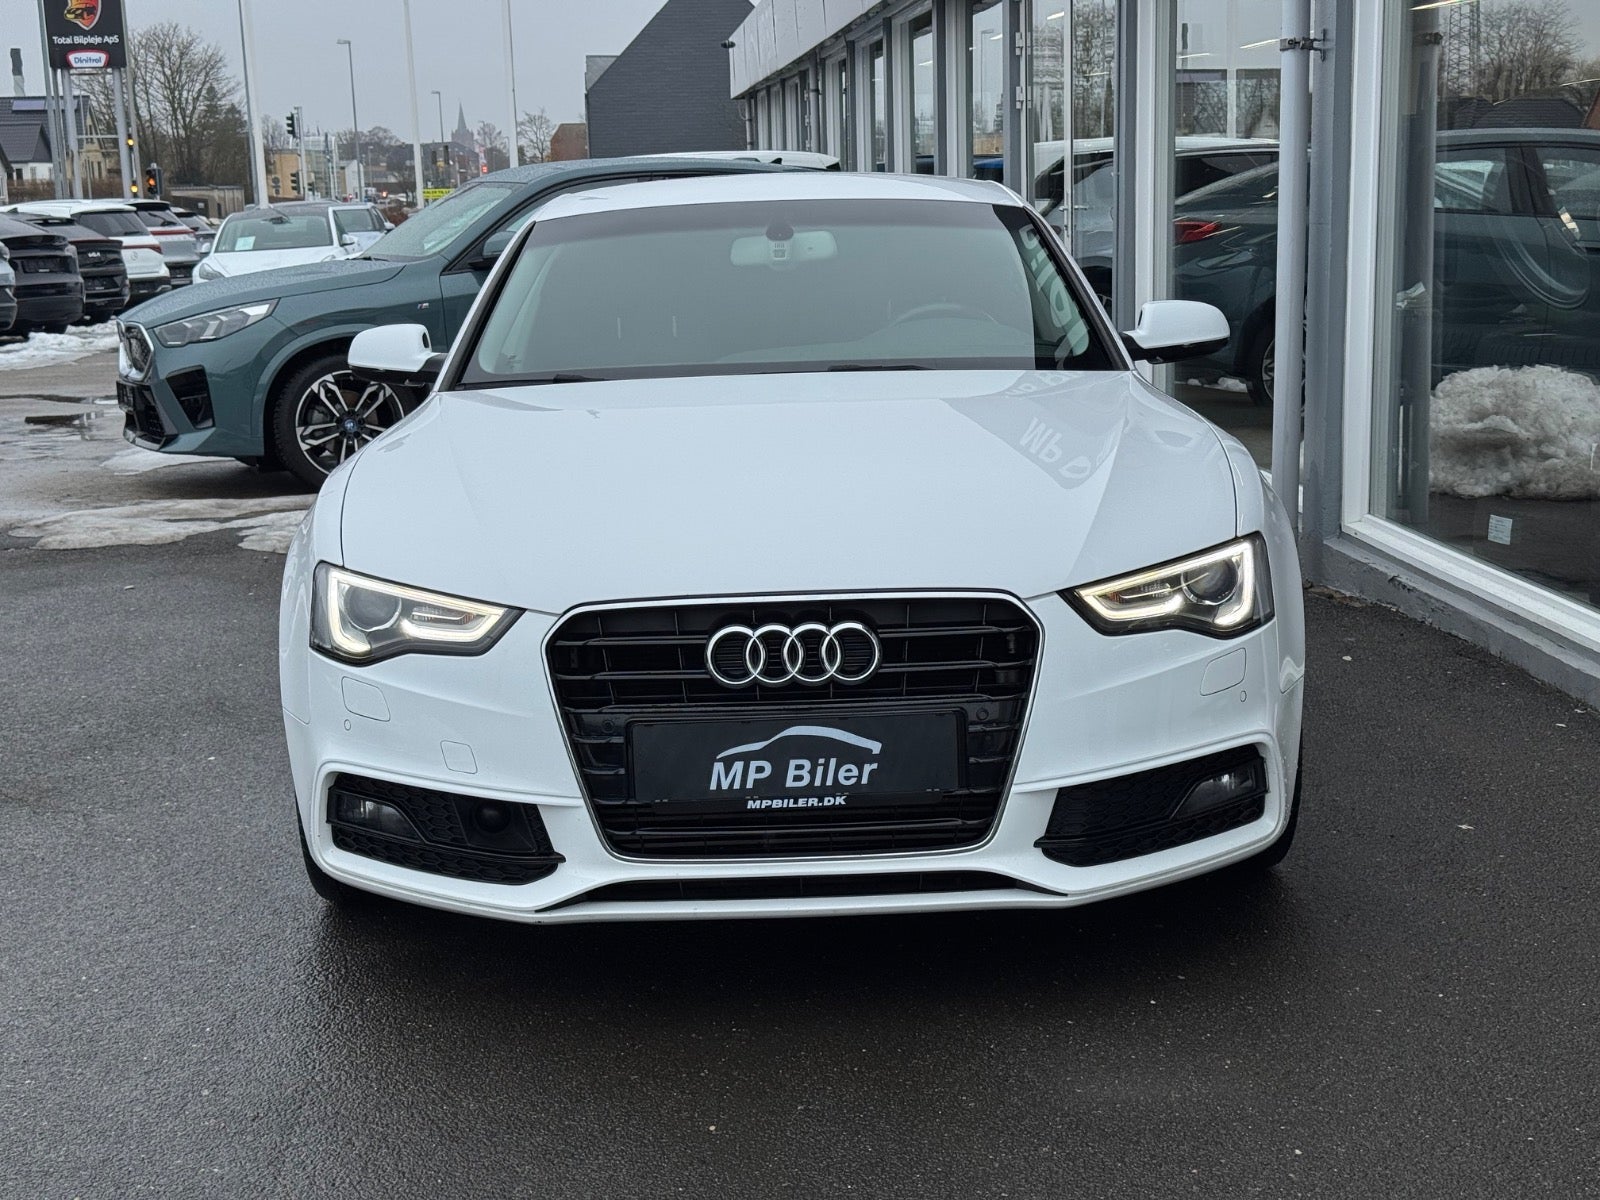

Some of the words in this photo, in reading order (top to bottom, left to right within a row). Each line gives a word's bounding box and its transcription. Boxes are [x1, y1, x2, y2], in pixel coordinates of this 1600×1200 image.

[52, 36, 73, 44] Total
[73, 35, 103, 46] Bilpleje
[103, 35, 120, 45] ApS
[73, 56, 102, 65] Dinitrol
[709, 760, 772, 791] MP
[785, 757, 878, 788] Biler
[746, 795, 848, 810] MPBILER.DK
